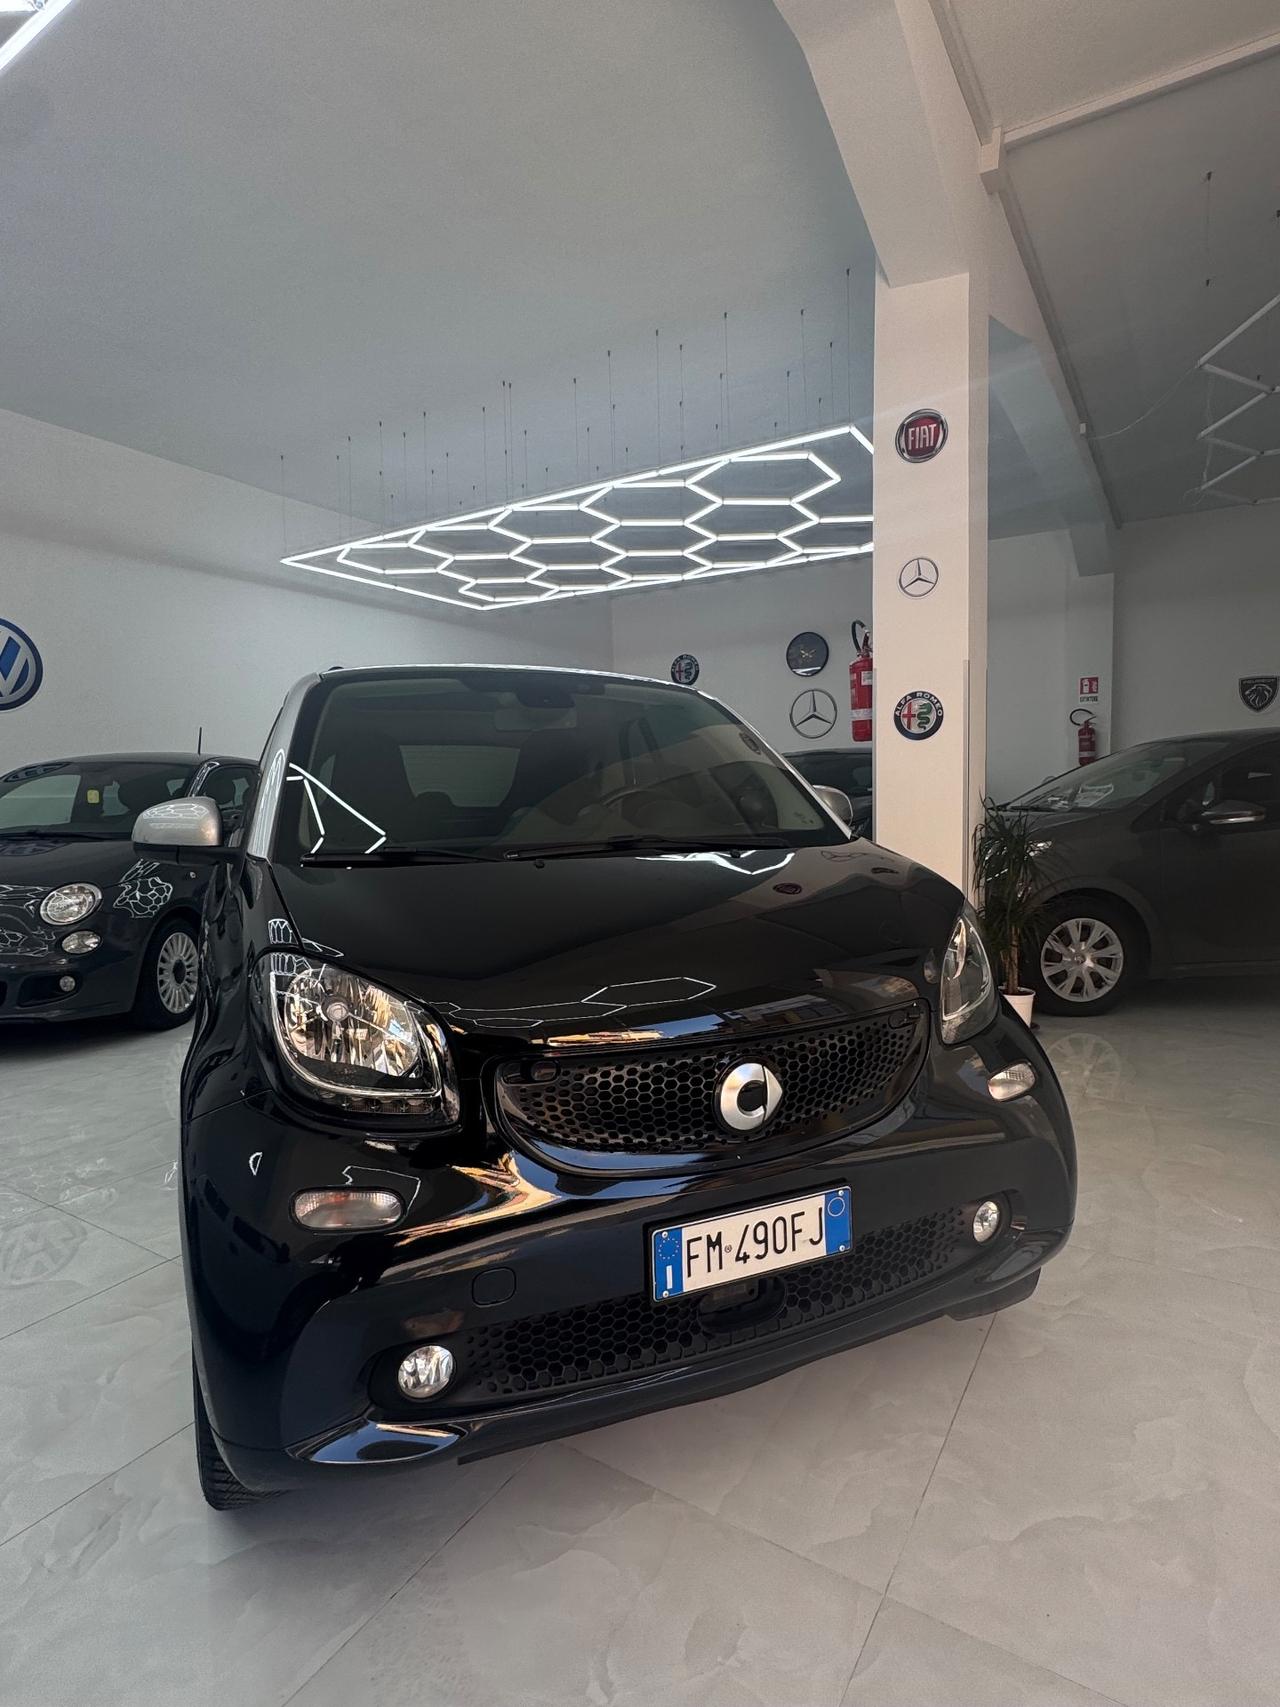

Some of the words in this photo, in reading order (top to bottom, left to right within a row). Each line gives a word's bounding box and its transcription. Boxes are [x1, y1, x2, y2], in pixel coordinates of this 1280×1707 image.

[908, 423, 937, 451] FIAT
[895, 695, 912, 717] ALFA
[916, 692, 943, 717] ROMEO
[666, 1265, 673, 1289] I
